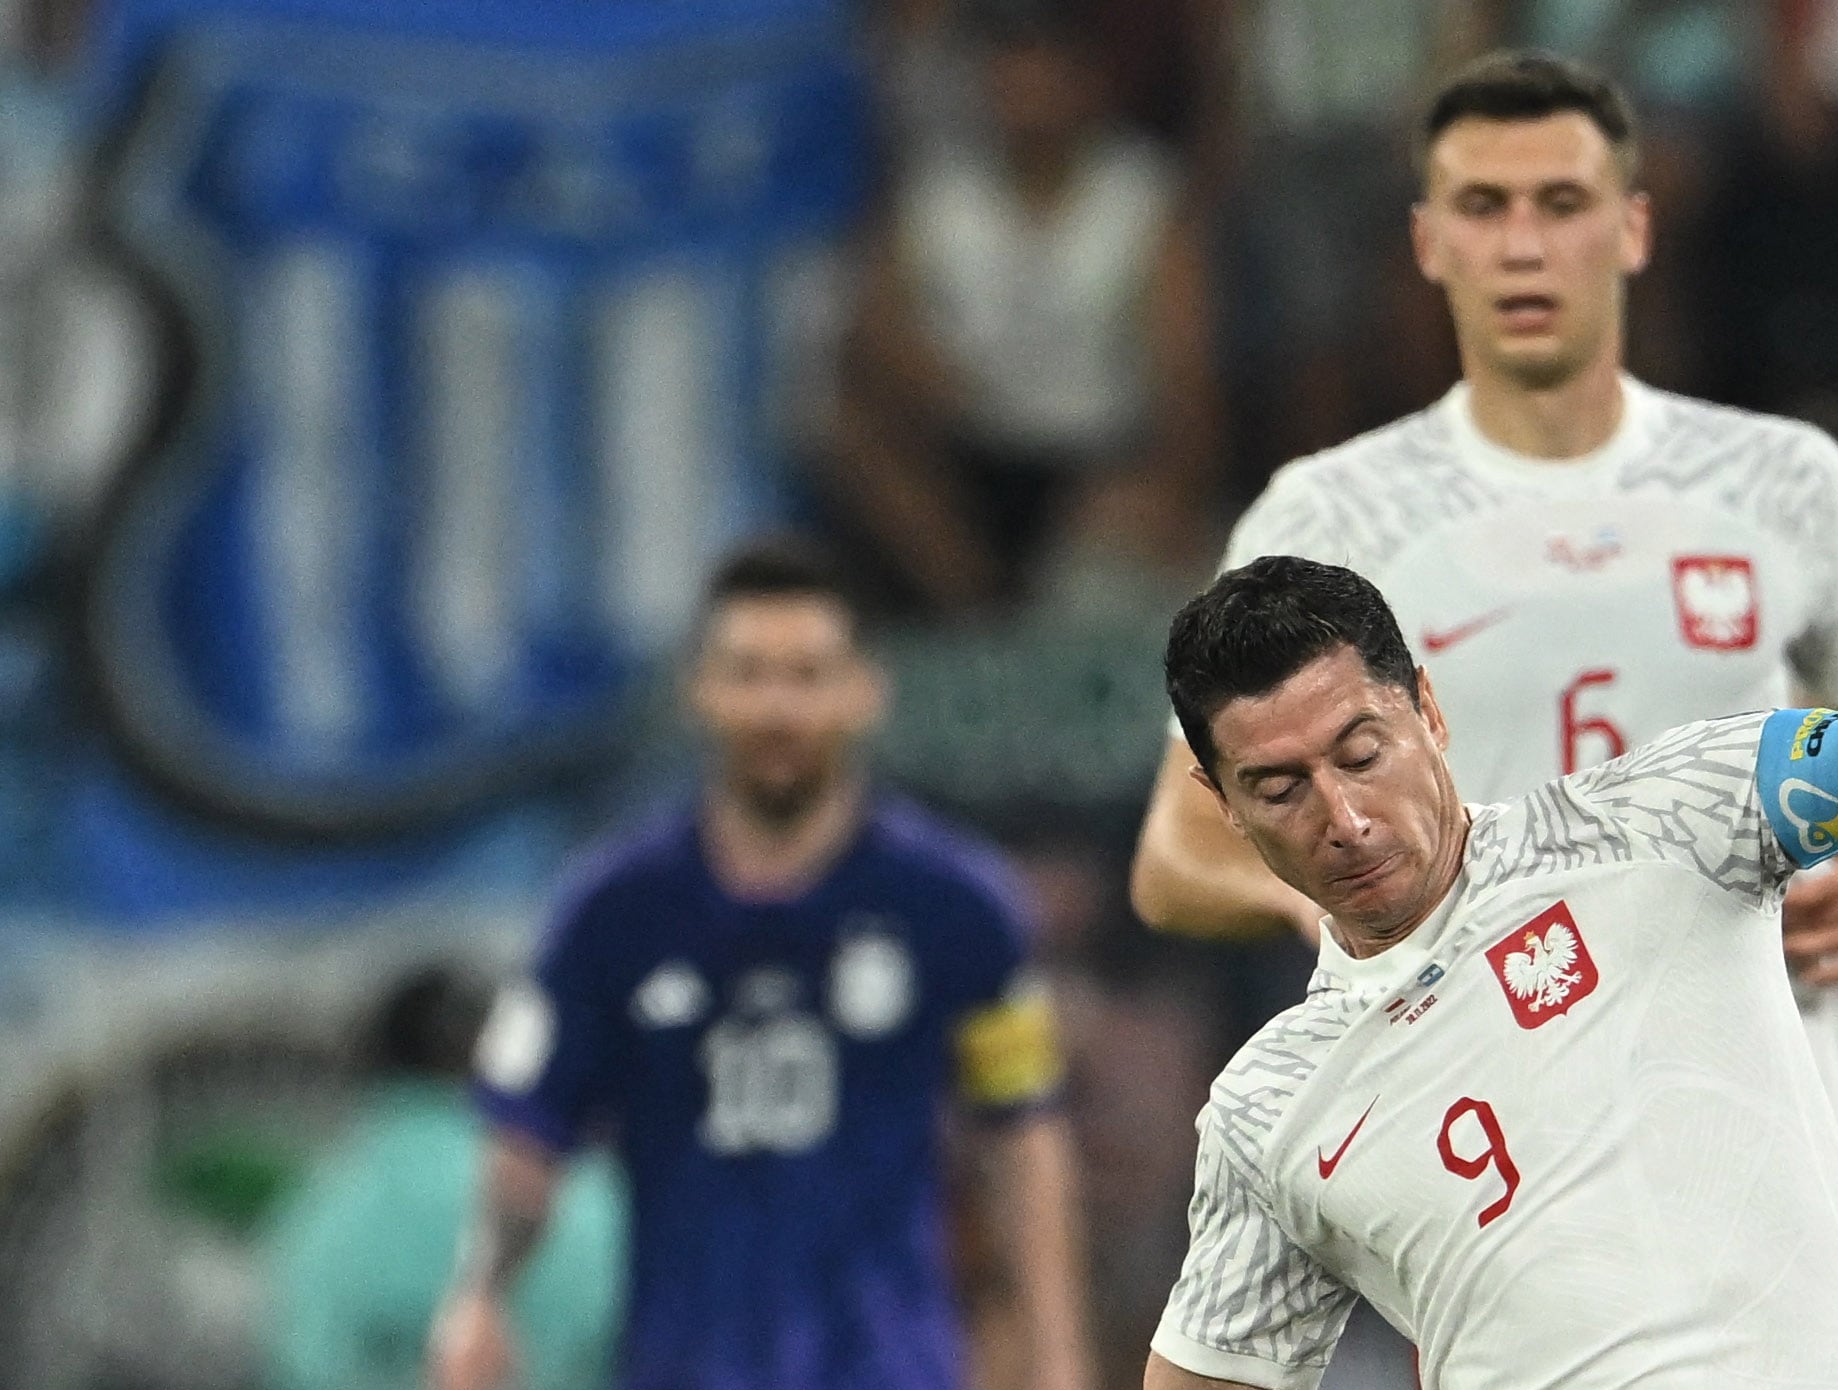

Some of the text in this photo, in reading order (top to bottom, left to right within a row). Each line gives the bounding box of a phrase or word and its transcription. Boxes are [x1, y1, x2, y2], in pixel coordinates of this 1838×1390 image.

[1557, 667, 1630, 775] 6
[698, 1015, 838, 1153] 10
[1437, 1096, 1521, 1230] 9
